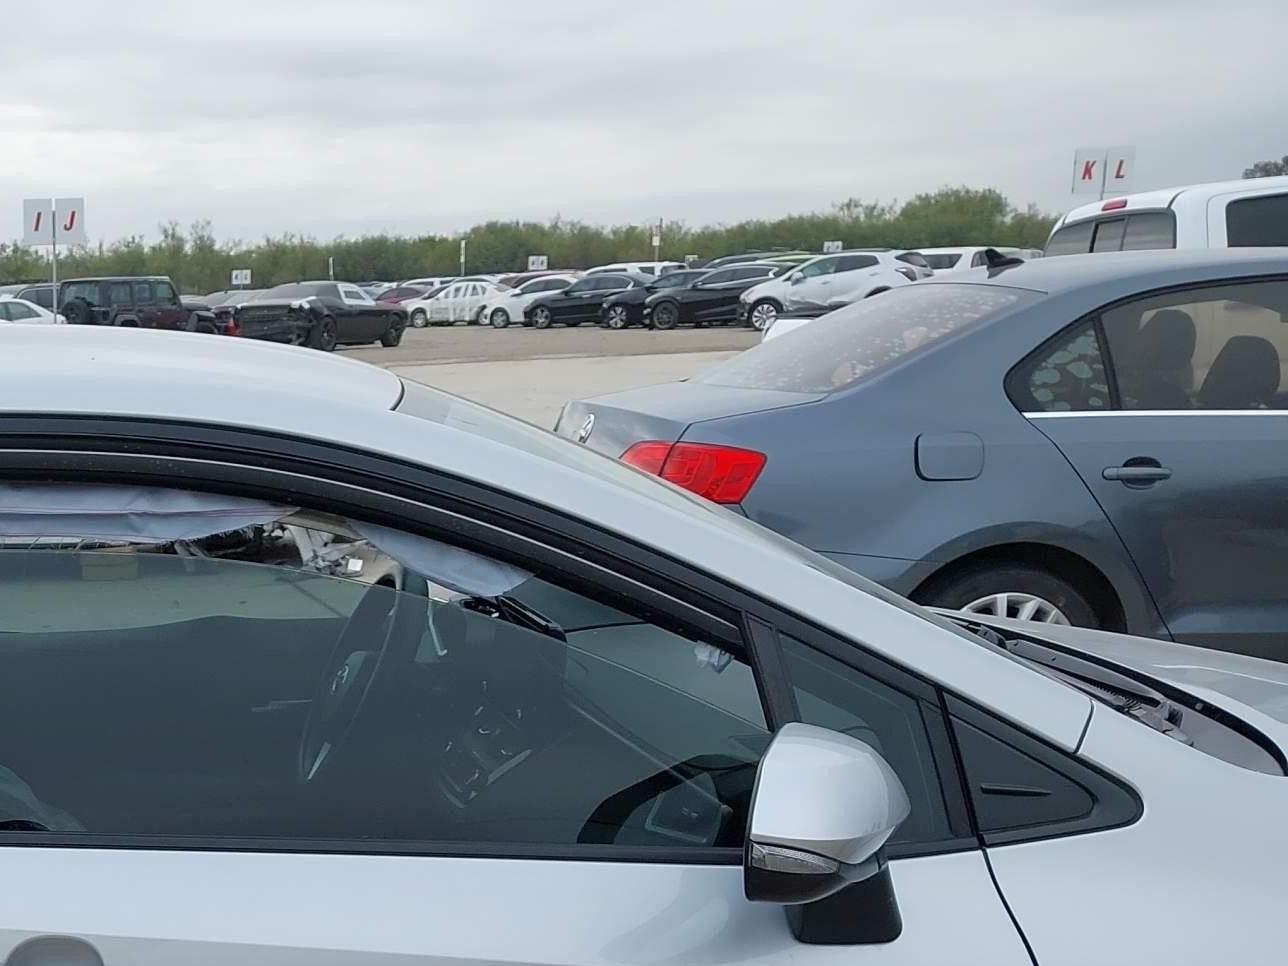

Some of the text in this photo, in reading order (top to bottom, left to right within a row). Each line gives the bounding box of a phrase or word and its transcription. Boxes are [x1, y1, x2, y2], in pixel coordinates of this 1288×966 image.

[1081, 159, 1125, 180] K L
[33, 210, 76, 232] I J
